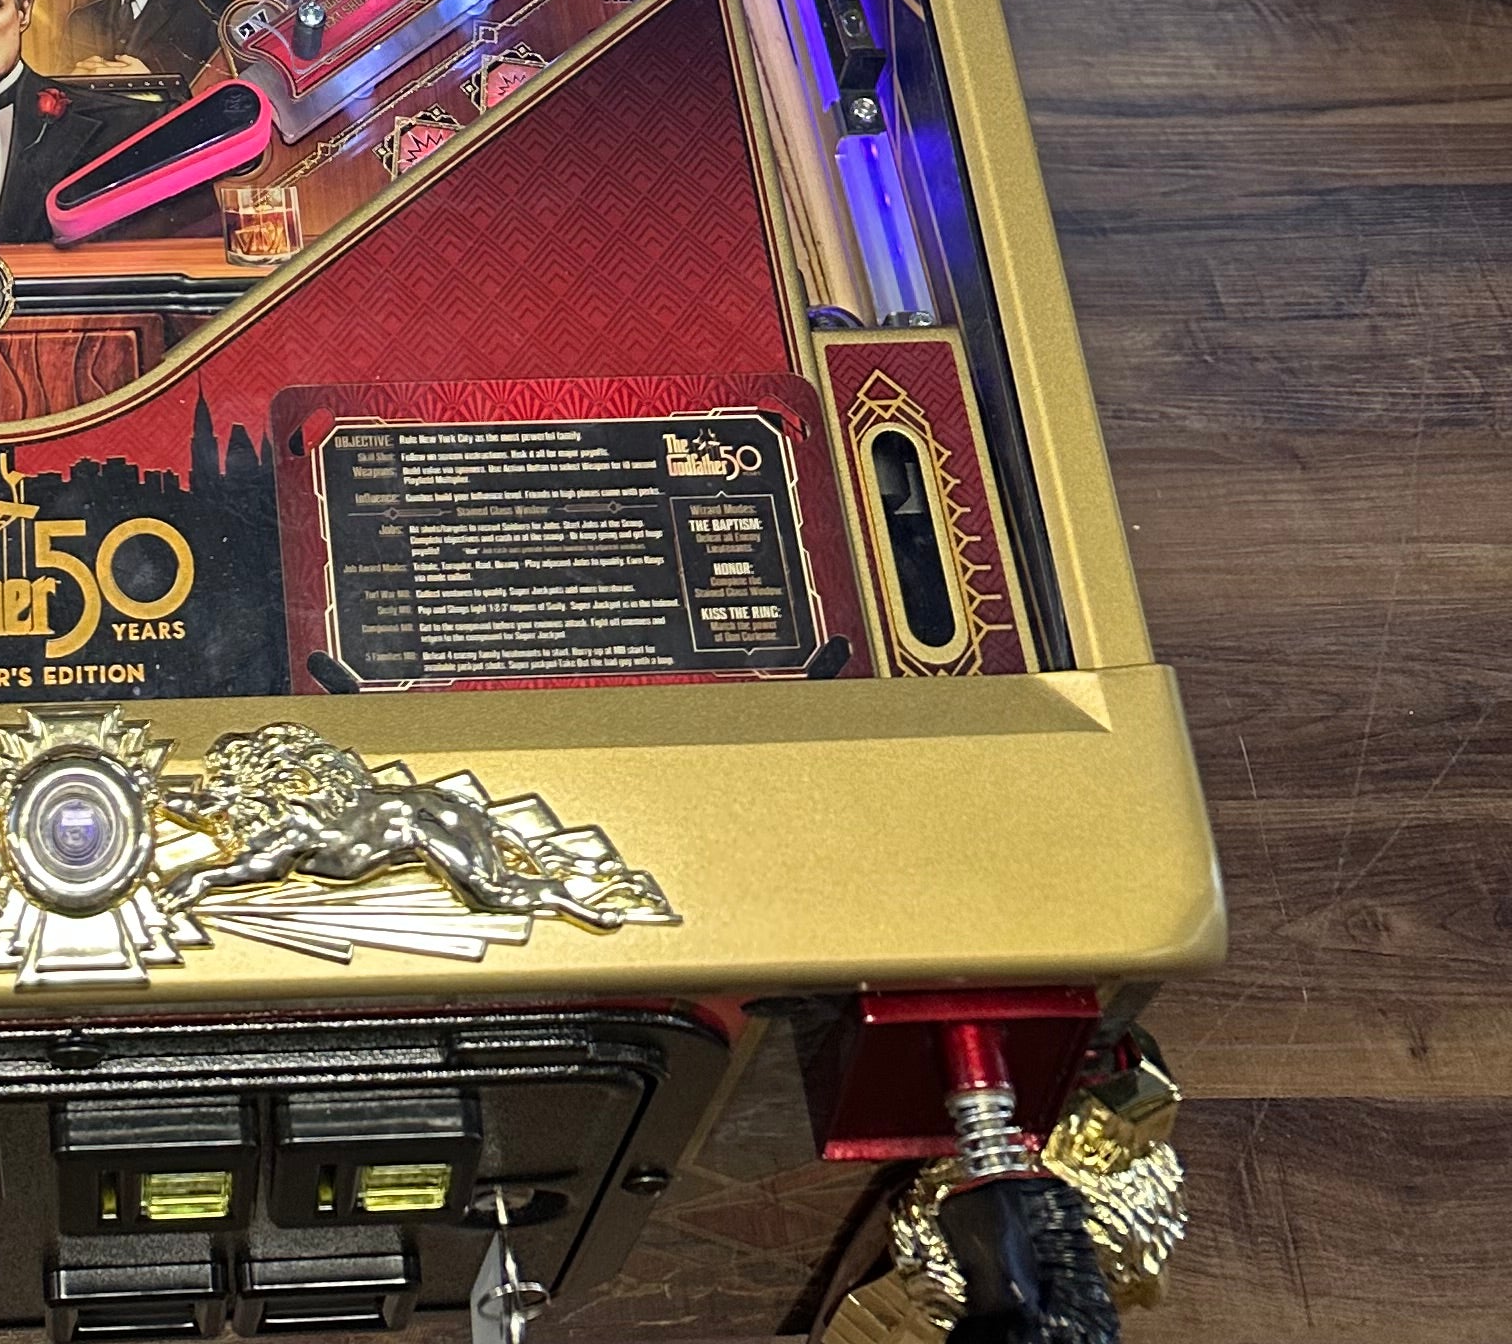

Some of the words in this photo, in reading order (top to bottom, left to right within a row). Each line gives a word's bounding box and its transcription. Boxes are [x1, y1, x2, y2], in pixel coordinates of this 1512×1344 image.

[335, 435, 394, 448] OBJECTIVE:
[663, 433, 688, 453] The
[666, 452, 727, 476] Godfather
[720, 446, 762, 480] 50
[689, 519, 709, 532] THE
[712, 519, 763, 532] BAPTISM:
[714, 562, 754, 575] HONOR:
[34, 517, 195, 660] 50
[701, 607, 727, 620] KISS
[729, 607, 751, 620] THE
[752, 605, 782, 619] RING:
[111, 621, 188, 642] YEARS
[42, 663, 145, 686] EDITION
